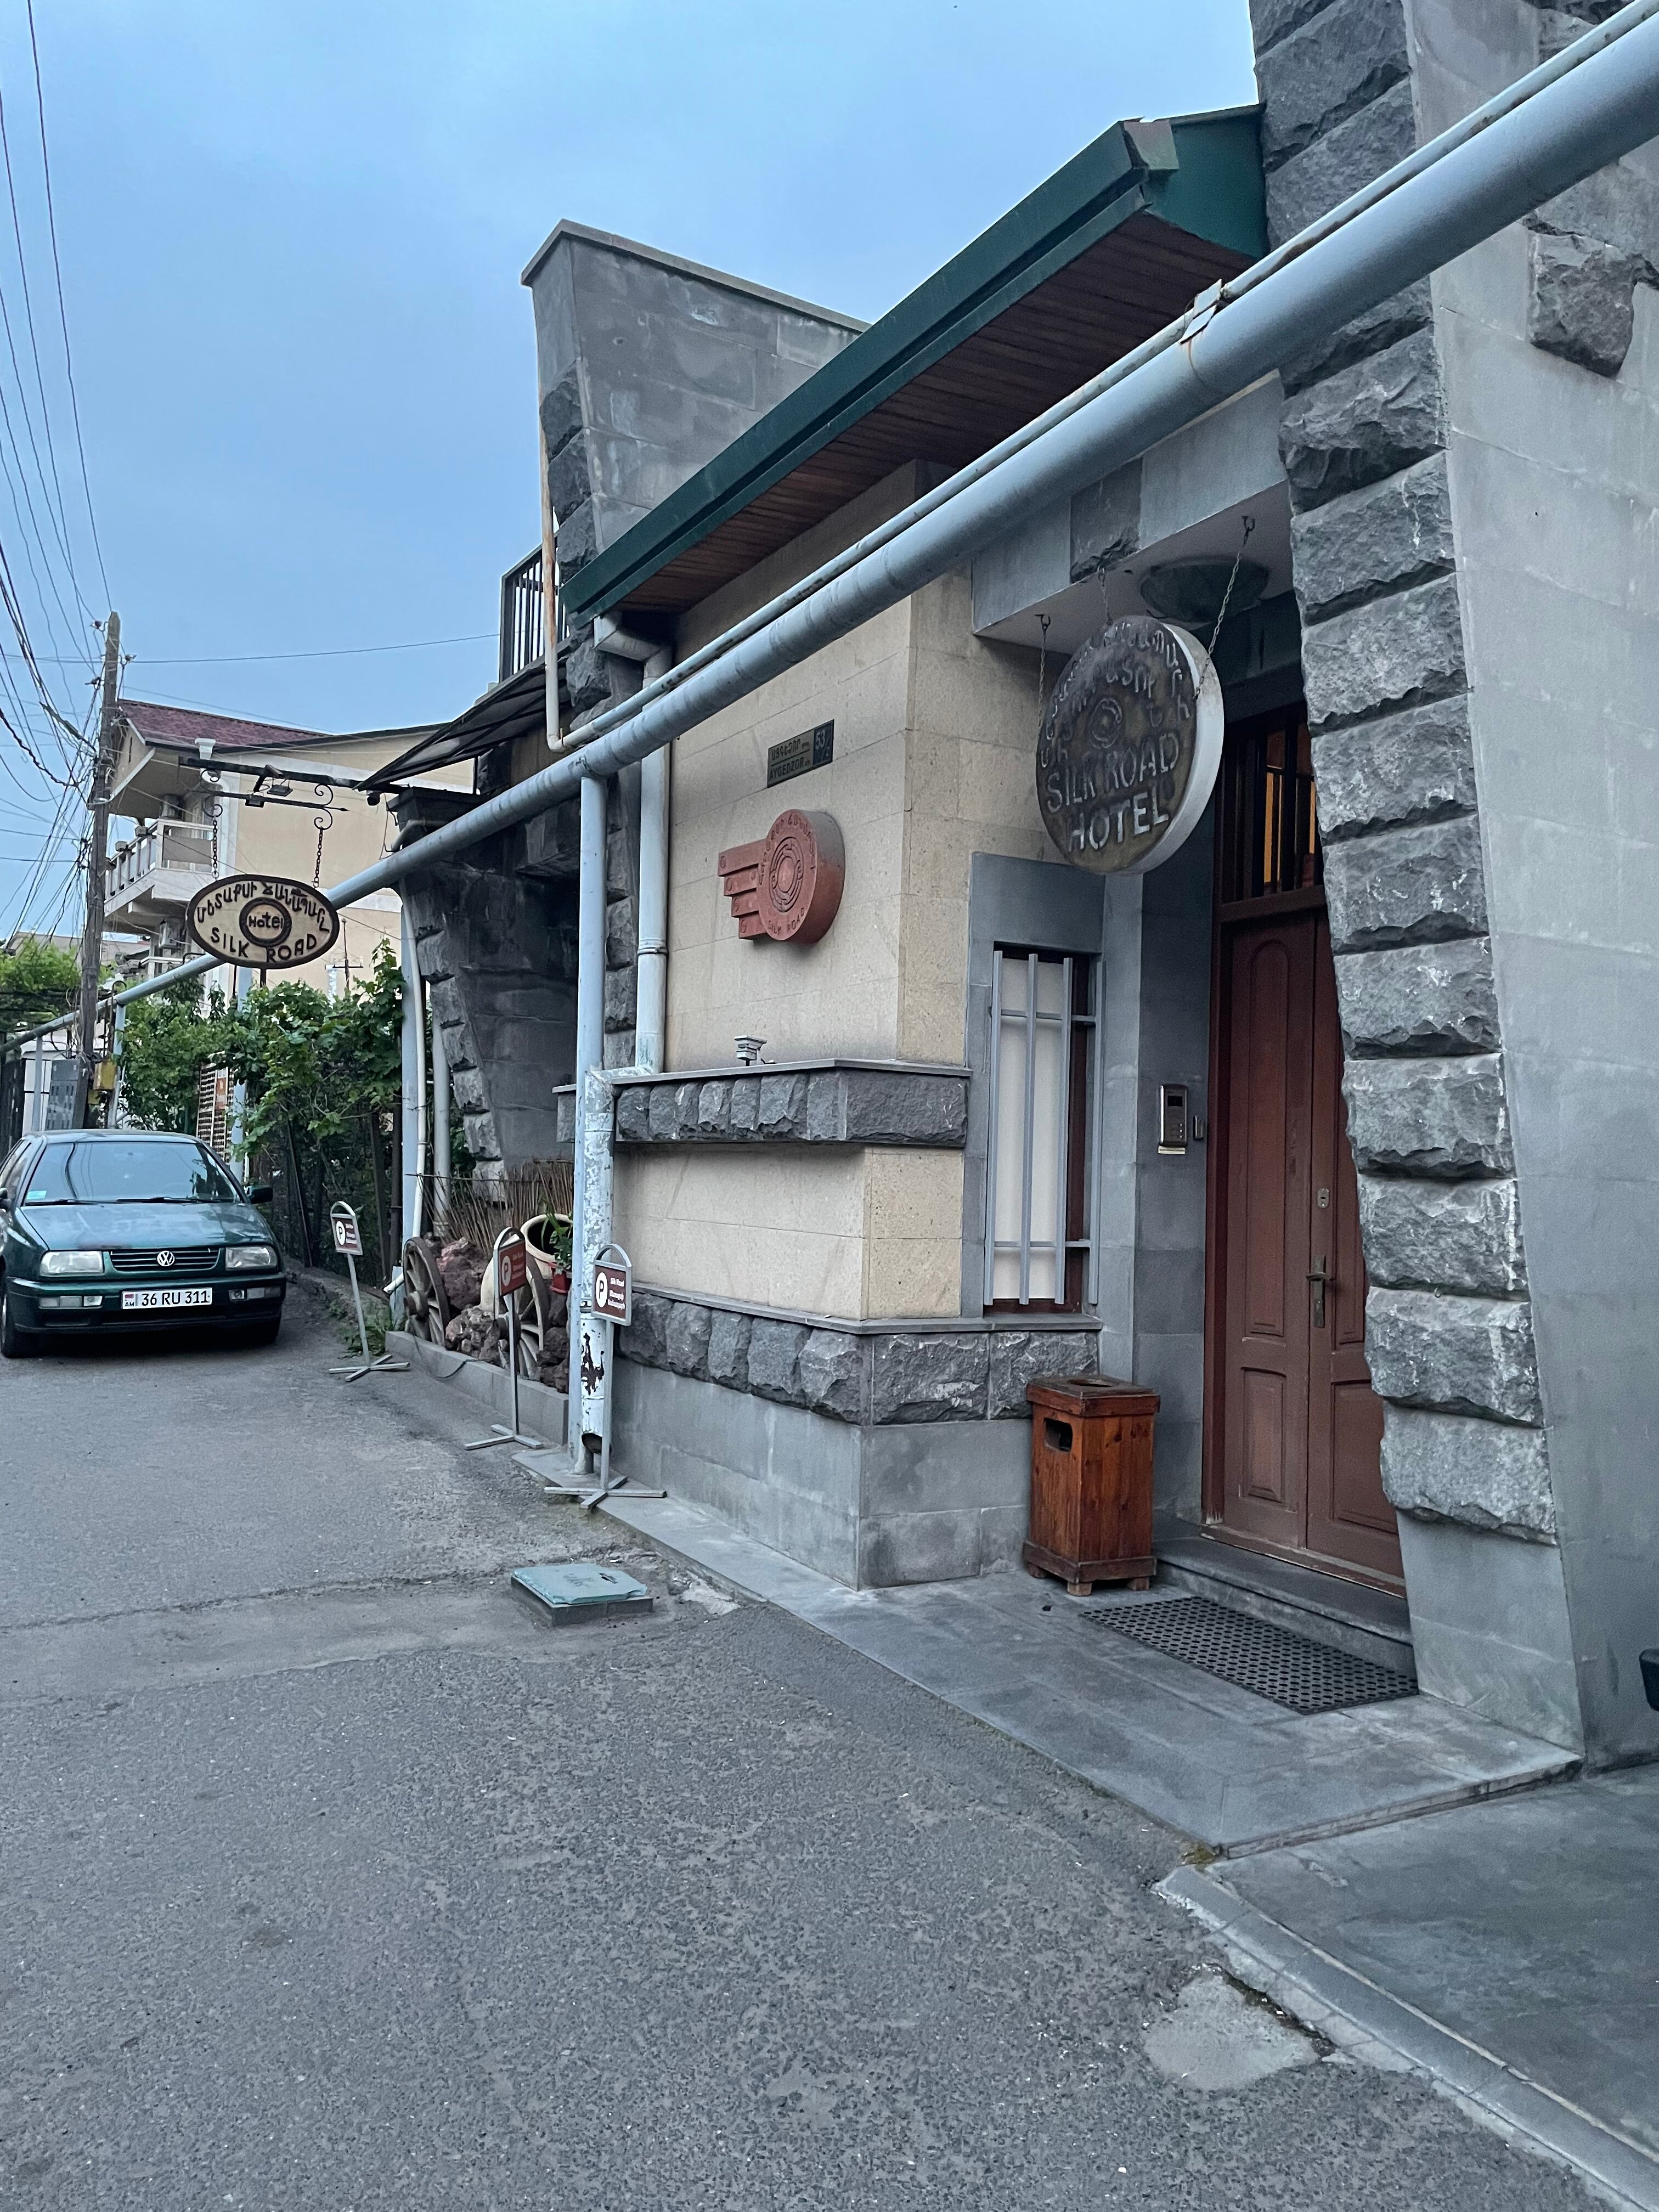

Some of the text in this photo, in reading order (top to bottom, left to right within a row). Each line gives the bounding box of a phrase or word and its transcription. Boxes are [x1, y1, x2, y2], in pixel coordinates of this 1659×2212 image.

[769, 757, 804, 780] AYGEDZOR
[1105, 733, 1179, 792] ROAD
[1069, 780, 1169, 852] HOTEL
[249, 912, 283, 929] Hotel
[211, 927, 317, 963] SILK ROAD
[504, 1262, 509, 1280] P
[142, 1293, 157, 1306] 36
[162, 1291, 180, 1305] RU
[185, 1290, 208, 1304] 311
[599, 1279, 604, 1300] P
